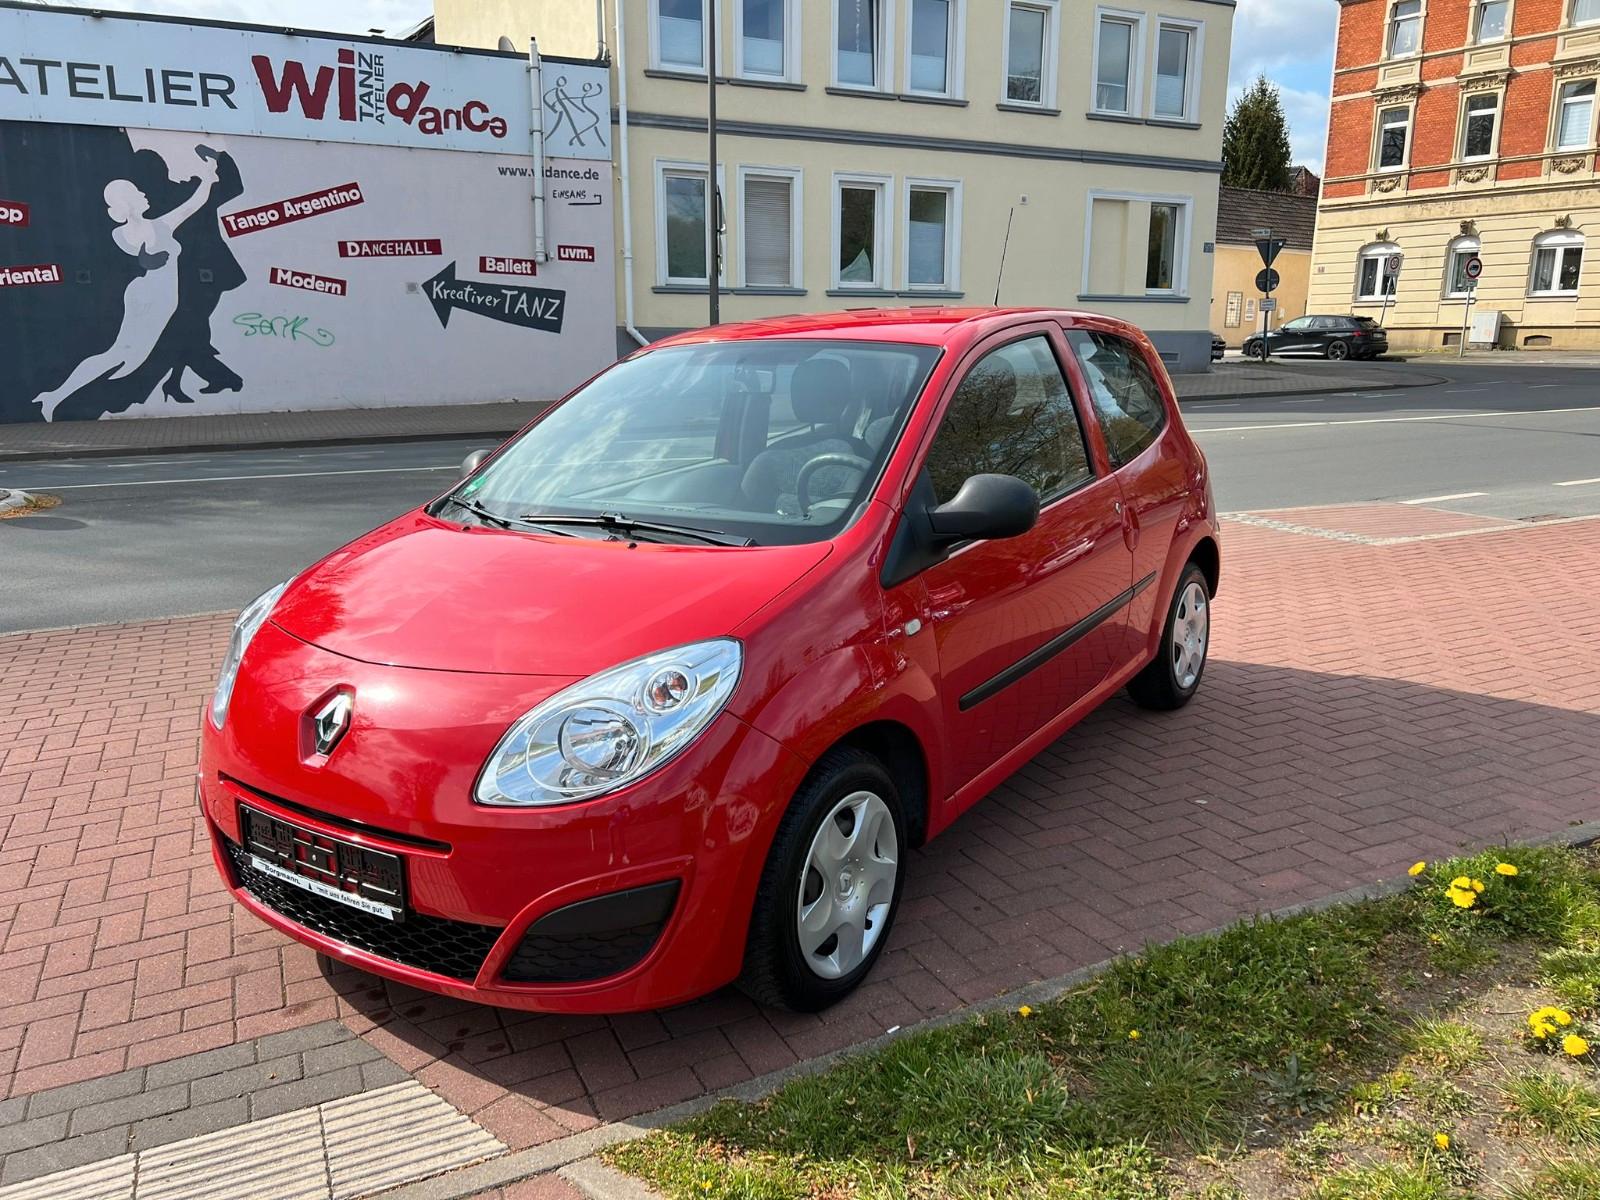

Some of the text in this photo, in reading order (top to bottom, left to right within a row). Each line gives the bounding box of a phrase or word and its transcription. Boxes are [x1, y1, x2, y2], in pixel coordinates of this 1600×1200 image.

[0, 56, 238, 109] ATELIER
[358, 51, 374, 123] TANZ
[373, 54, 385, 125] ATELIER
[498, 166, 600, 180] www.idance.de
[226, 187, 361, 232] Tango Argentino
[347, 241, 433, 257] DANCEHALL
[485, 257, 532, 274] Ballett
[560, 247, 593, 260] uvm.
[276, 269, 342, 295] Modern
[432, 280, 561, 320] Kreativer TANZ
